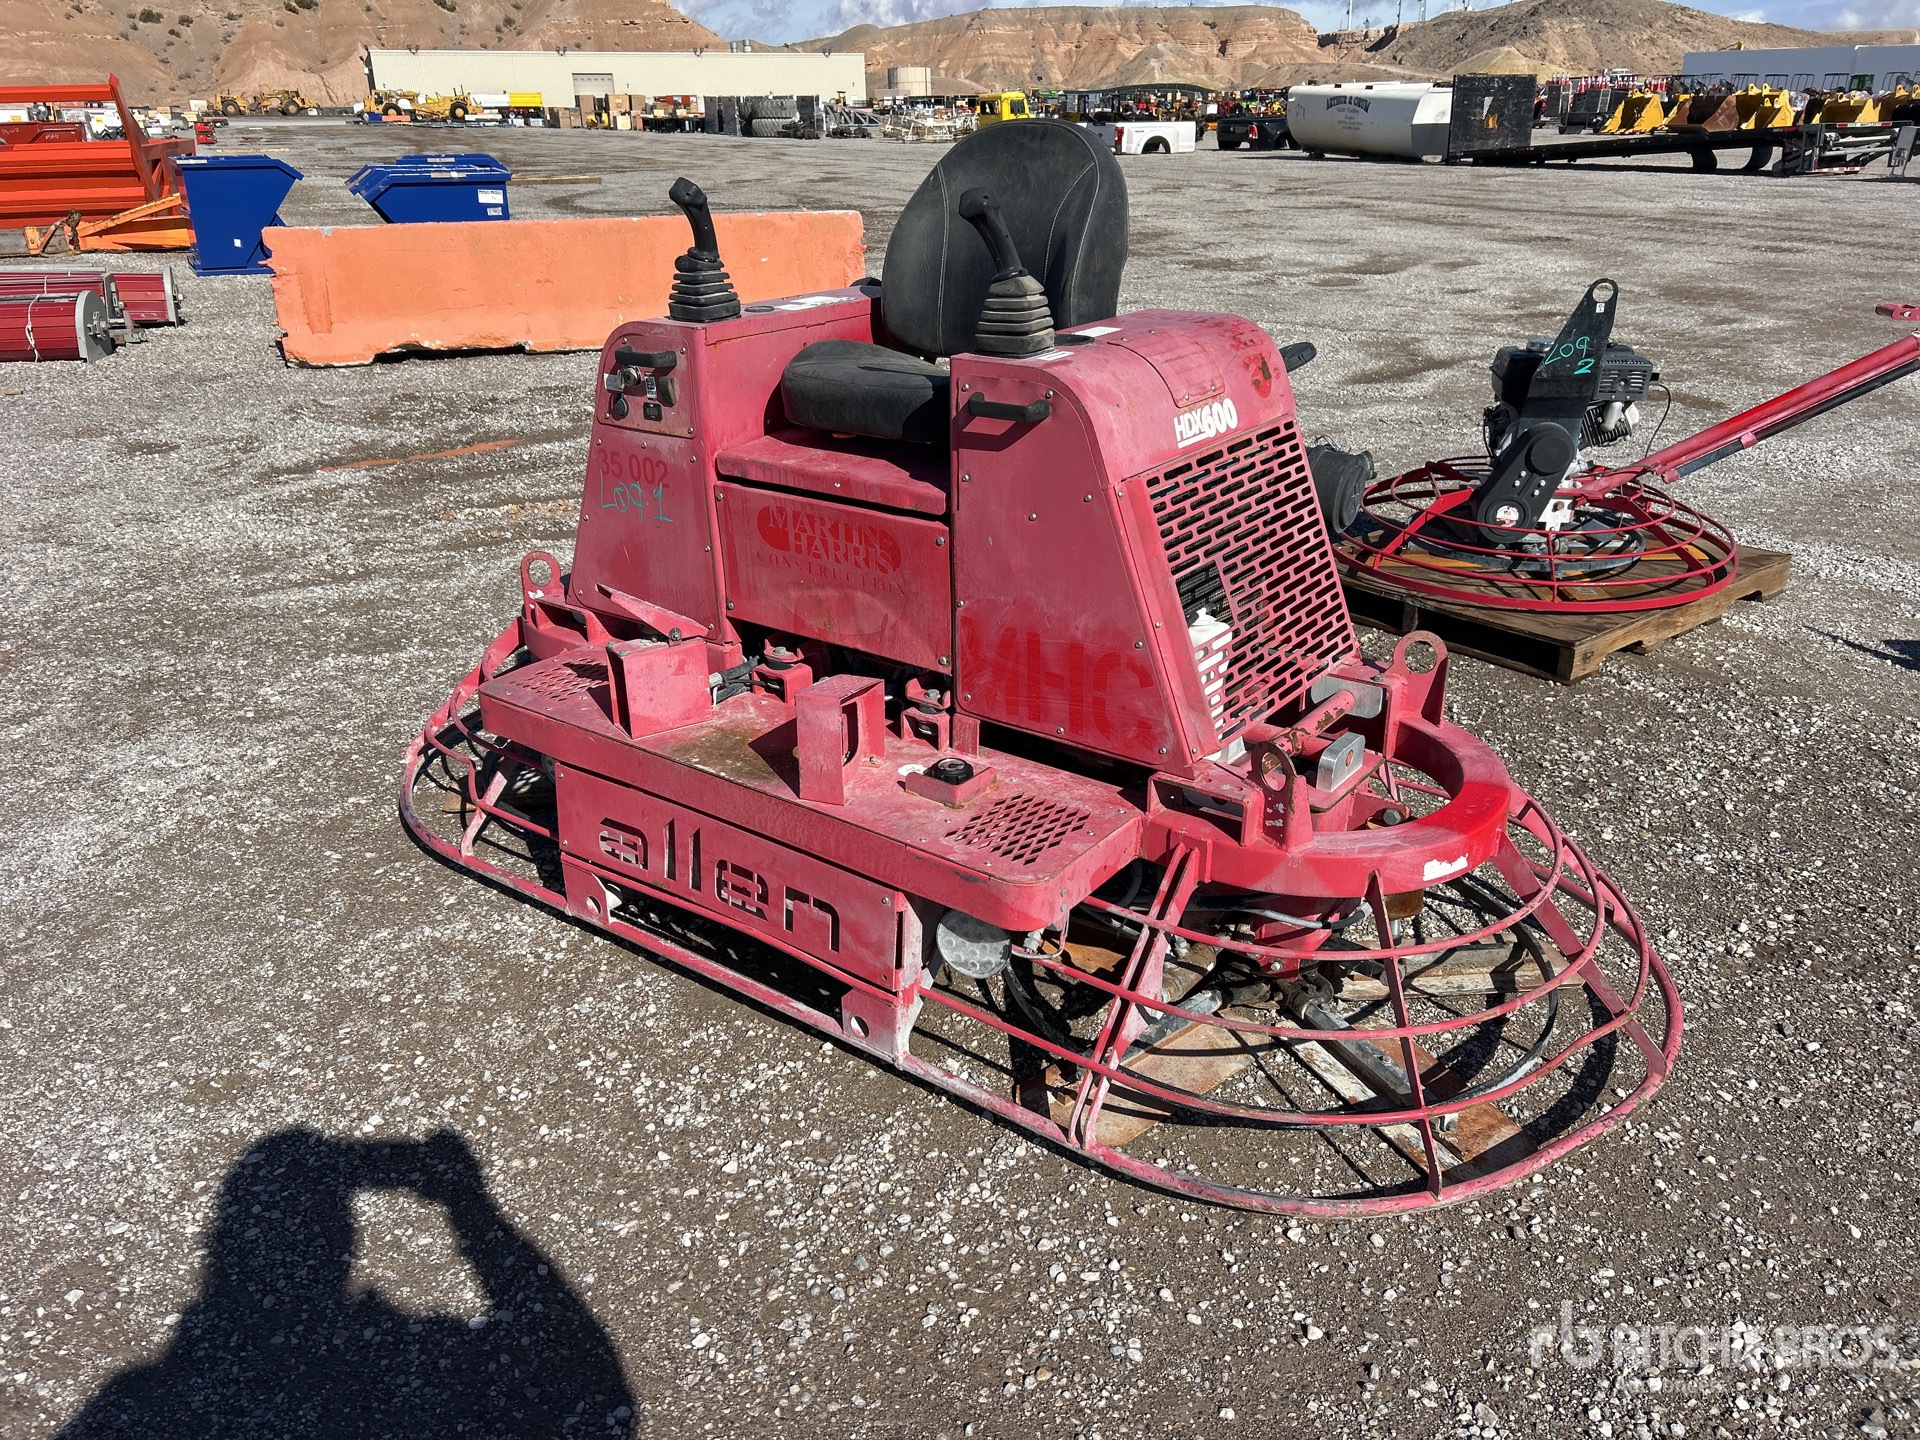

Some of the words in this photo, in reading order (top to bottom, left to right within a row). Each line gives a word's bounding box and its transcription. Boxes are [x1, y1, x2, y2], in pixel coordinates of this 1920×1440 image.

[1174, 398, 1238, 443] HDX600
[768, 500, 883, 553] MARTIN
[756, 549, 907, 598] CONSTRUCTION
[786, 532, 897, 576] HARRIS
[599, 817, 841, 934] allen
